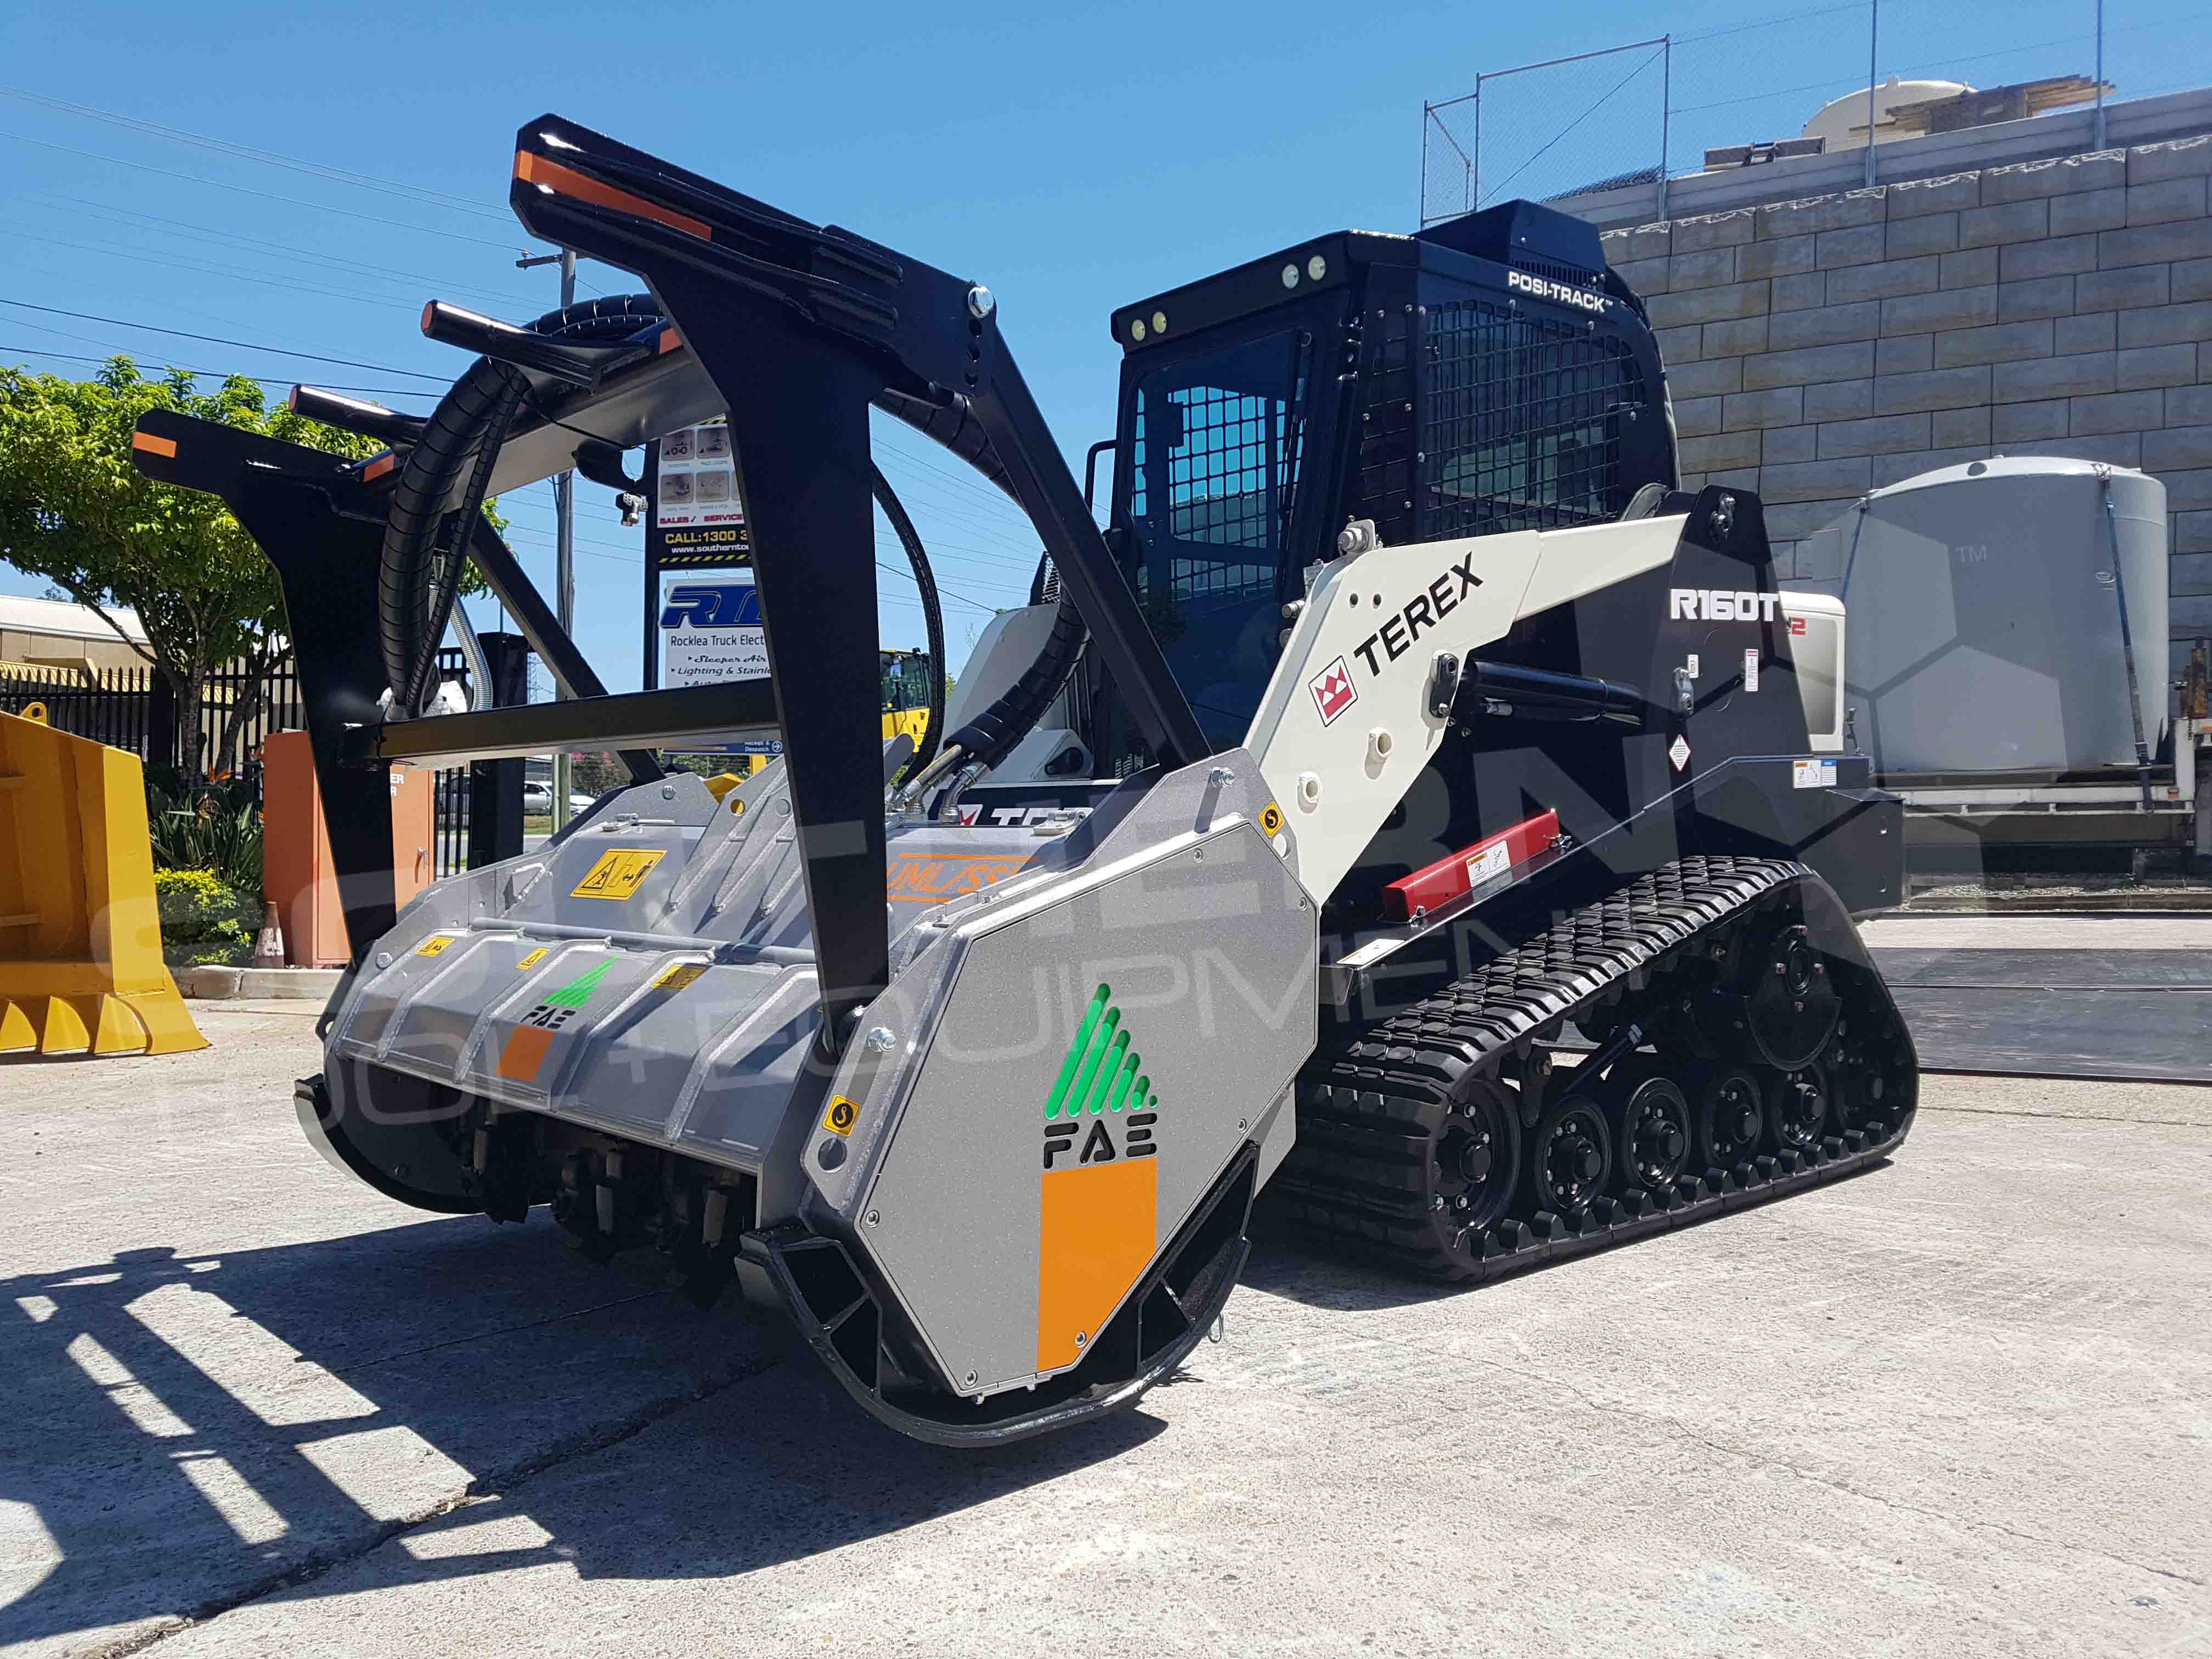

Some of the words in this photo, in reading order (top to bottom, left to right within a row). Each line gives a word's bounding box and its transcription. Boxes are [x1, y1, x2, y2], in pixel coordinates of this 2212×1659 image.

[704, 514, 743, 522] SERVICE
[1353, 550, 1484, 678] TEREX
[1670, 589, 1779, 622] R160T
[670, 635, 708, 646] Rocklea
[711, 635, 737, 646] Truck
[740, 634, 764, 645] Elect
[694, 655, 742, 664] Sleeper
[678, 667, 723, 676] Lighting
[520, 1005, 577, 1029] FAE
[1043, 1113, 1158, 1169] FAE
